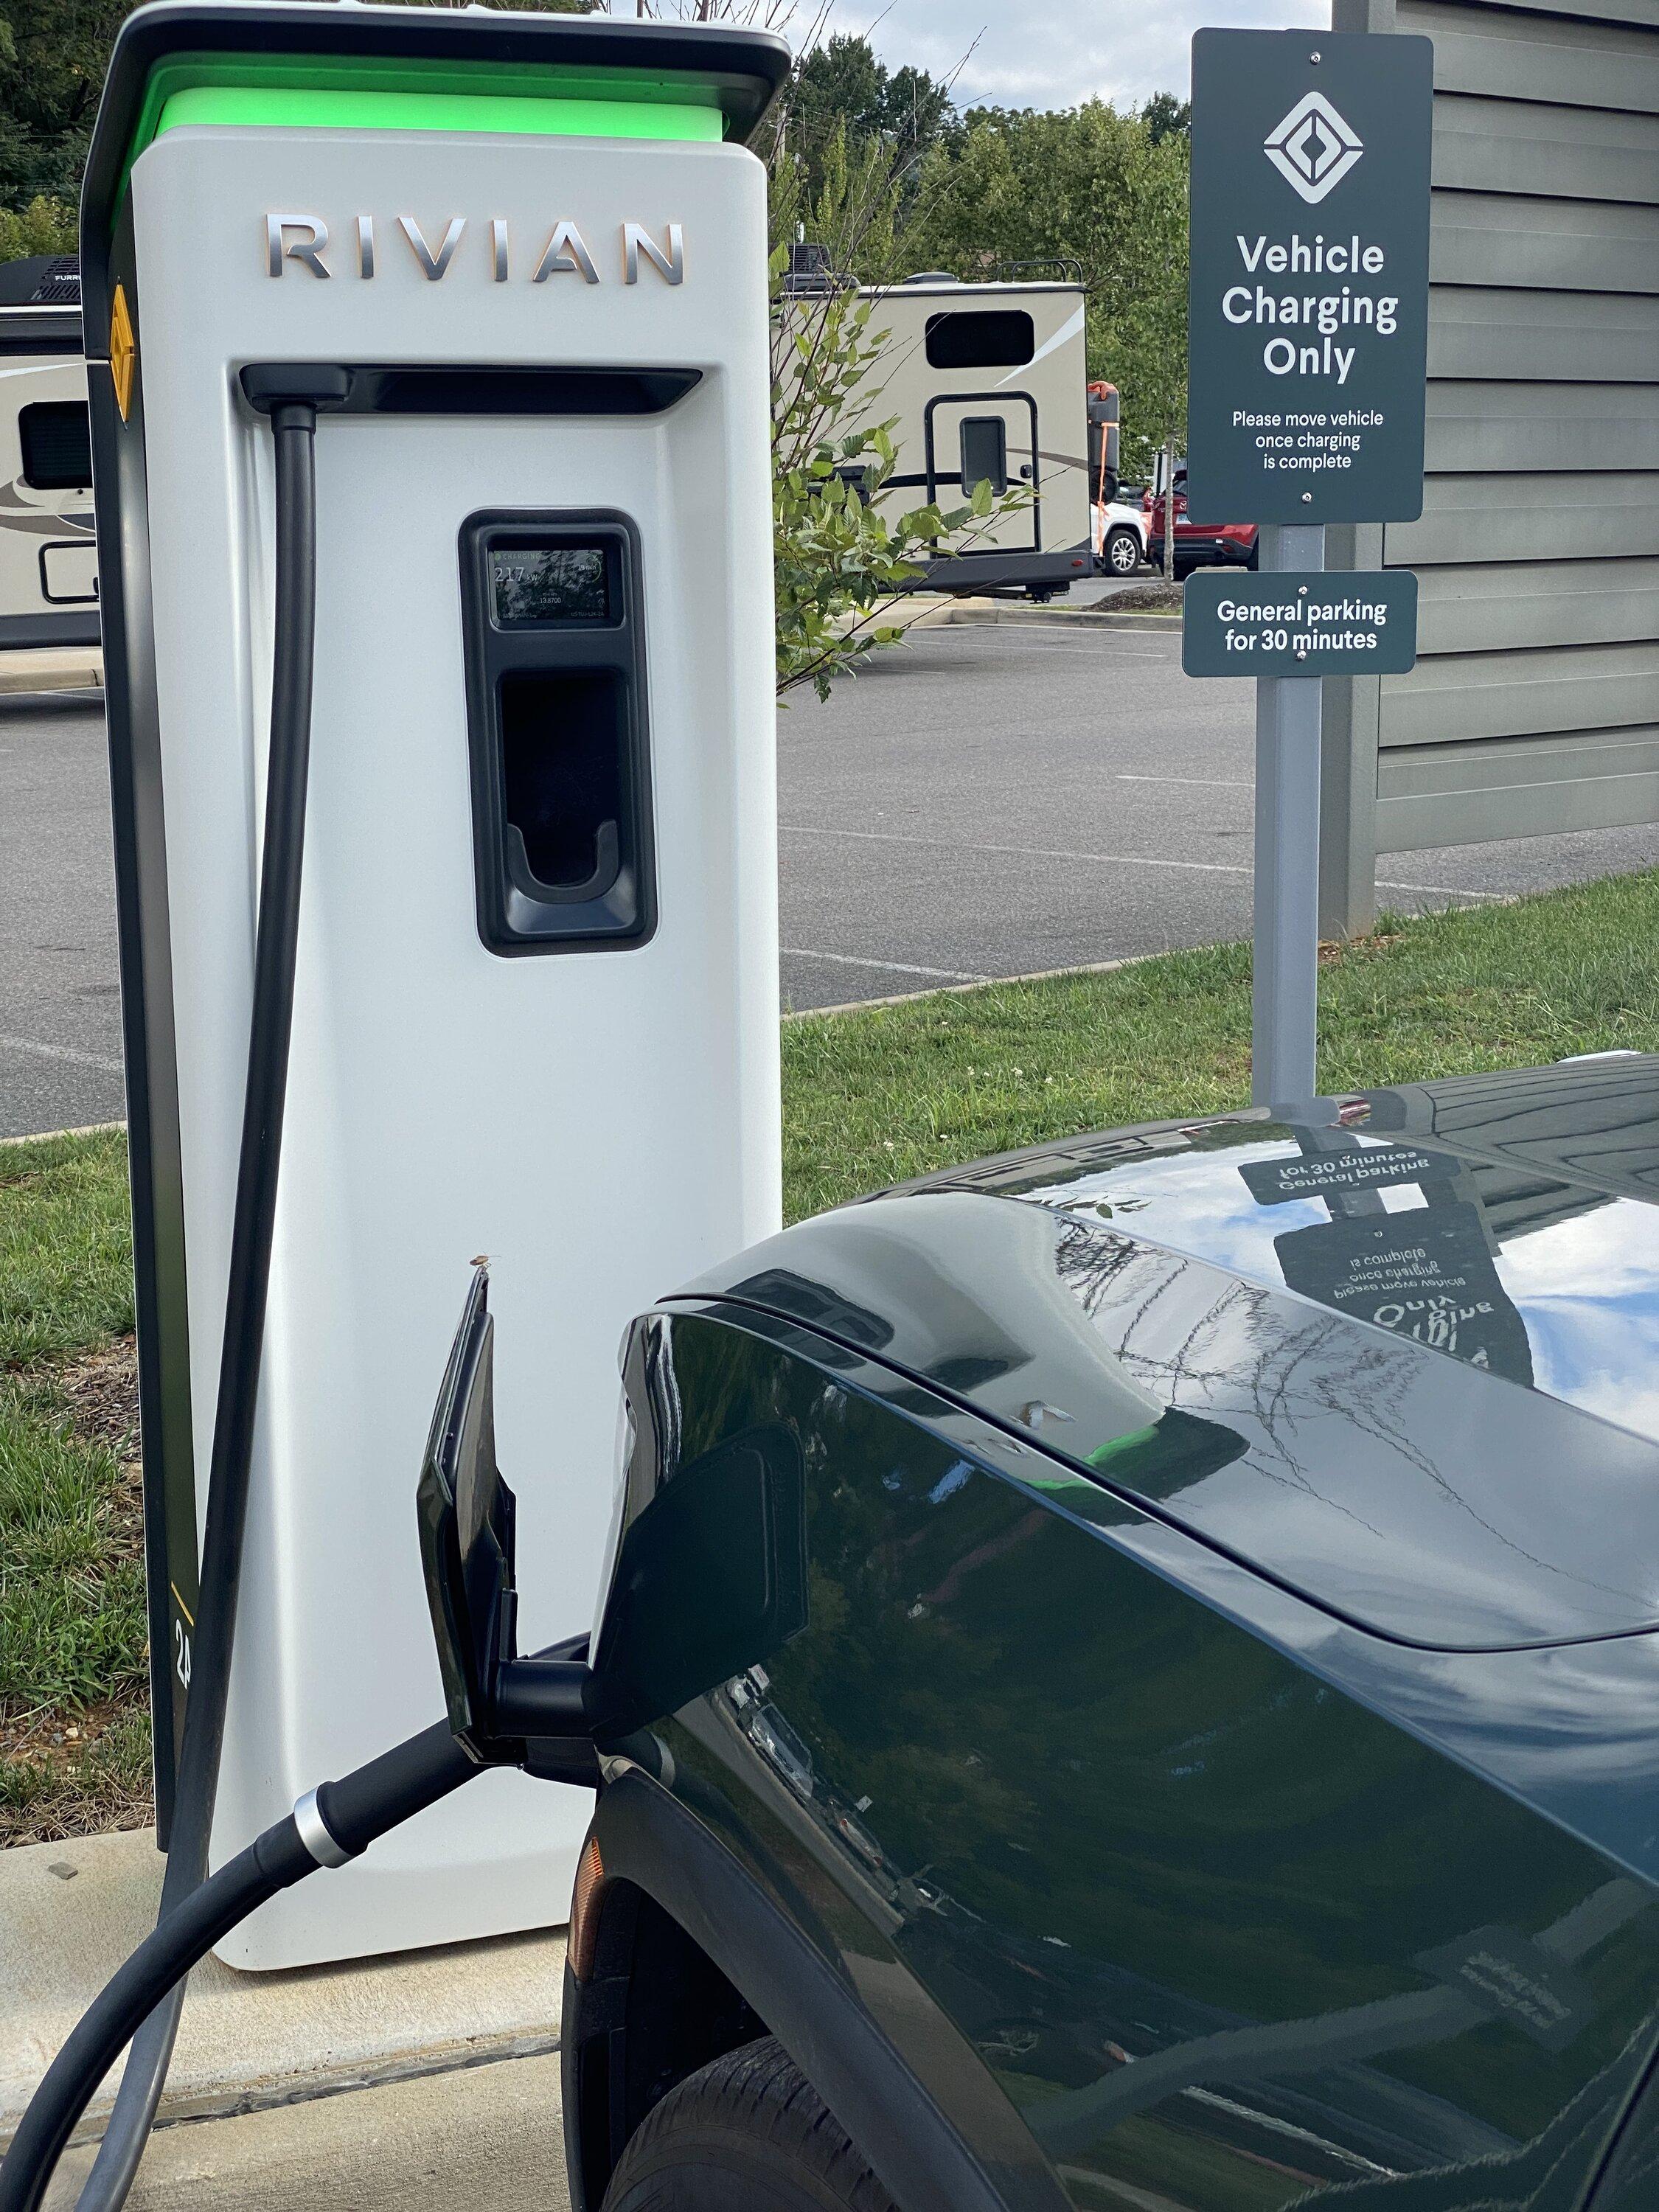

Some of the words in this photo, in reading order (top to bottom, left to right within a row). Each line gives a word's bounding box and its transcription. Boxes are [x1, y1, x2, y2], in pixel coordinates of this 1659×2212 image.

[265, 213, 684, 285] RIVIAN
[1237, 234, 1384, 274] Vehicle
[1222, 285, 1399, 335] Charging
[1263, 336, 1356, 385] Only
[1233, 411, 1281, 427] Please
[1285, 414, 1326, 426] move
[1330, 409, 1384, 426] vehicle
[1255, 436, 1294, 448] once
[1297, 431, 1361, 451] charging
[1264, 453, 1276, 469] is
[1279, 452, 1352, 473] complete
[495, 566, 524, 582] 217
[1217, 599, 1302, 622] General
[1307, 598, 1388, 626] parking
[1225, 628, 1257, 650] for
[1261, 629, 1288, 650] 30
[1293, 627, 1377, 650] minutes
